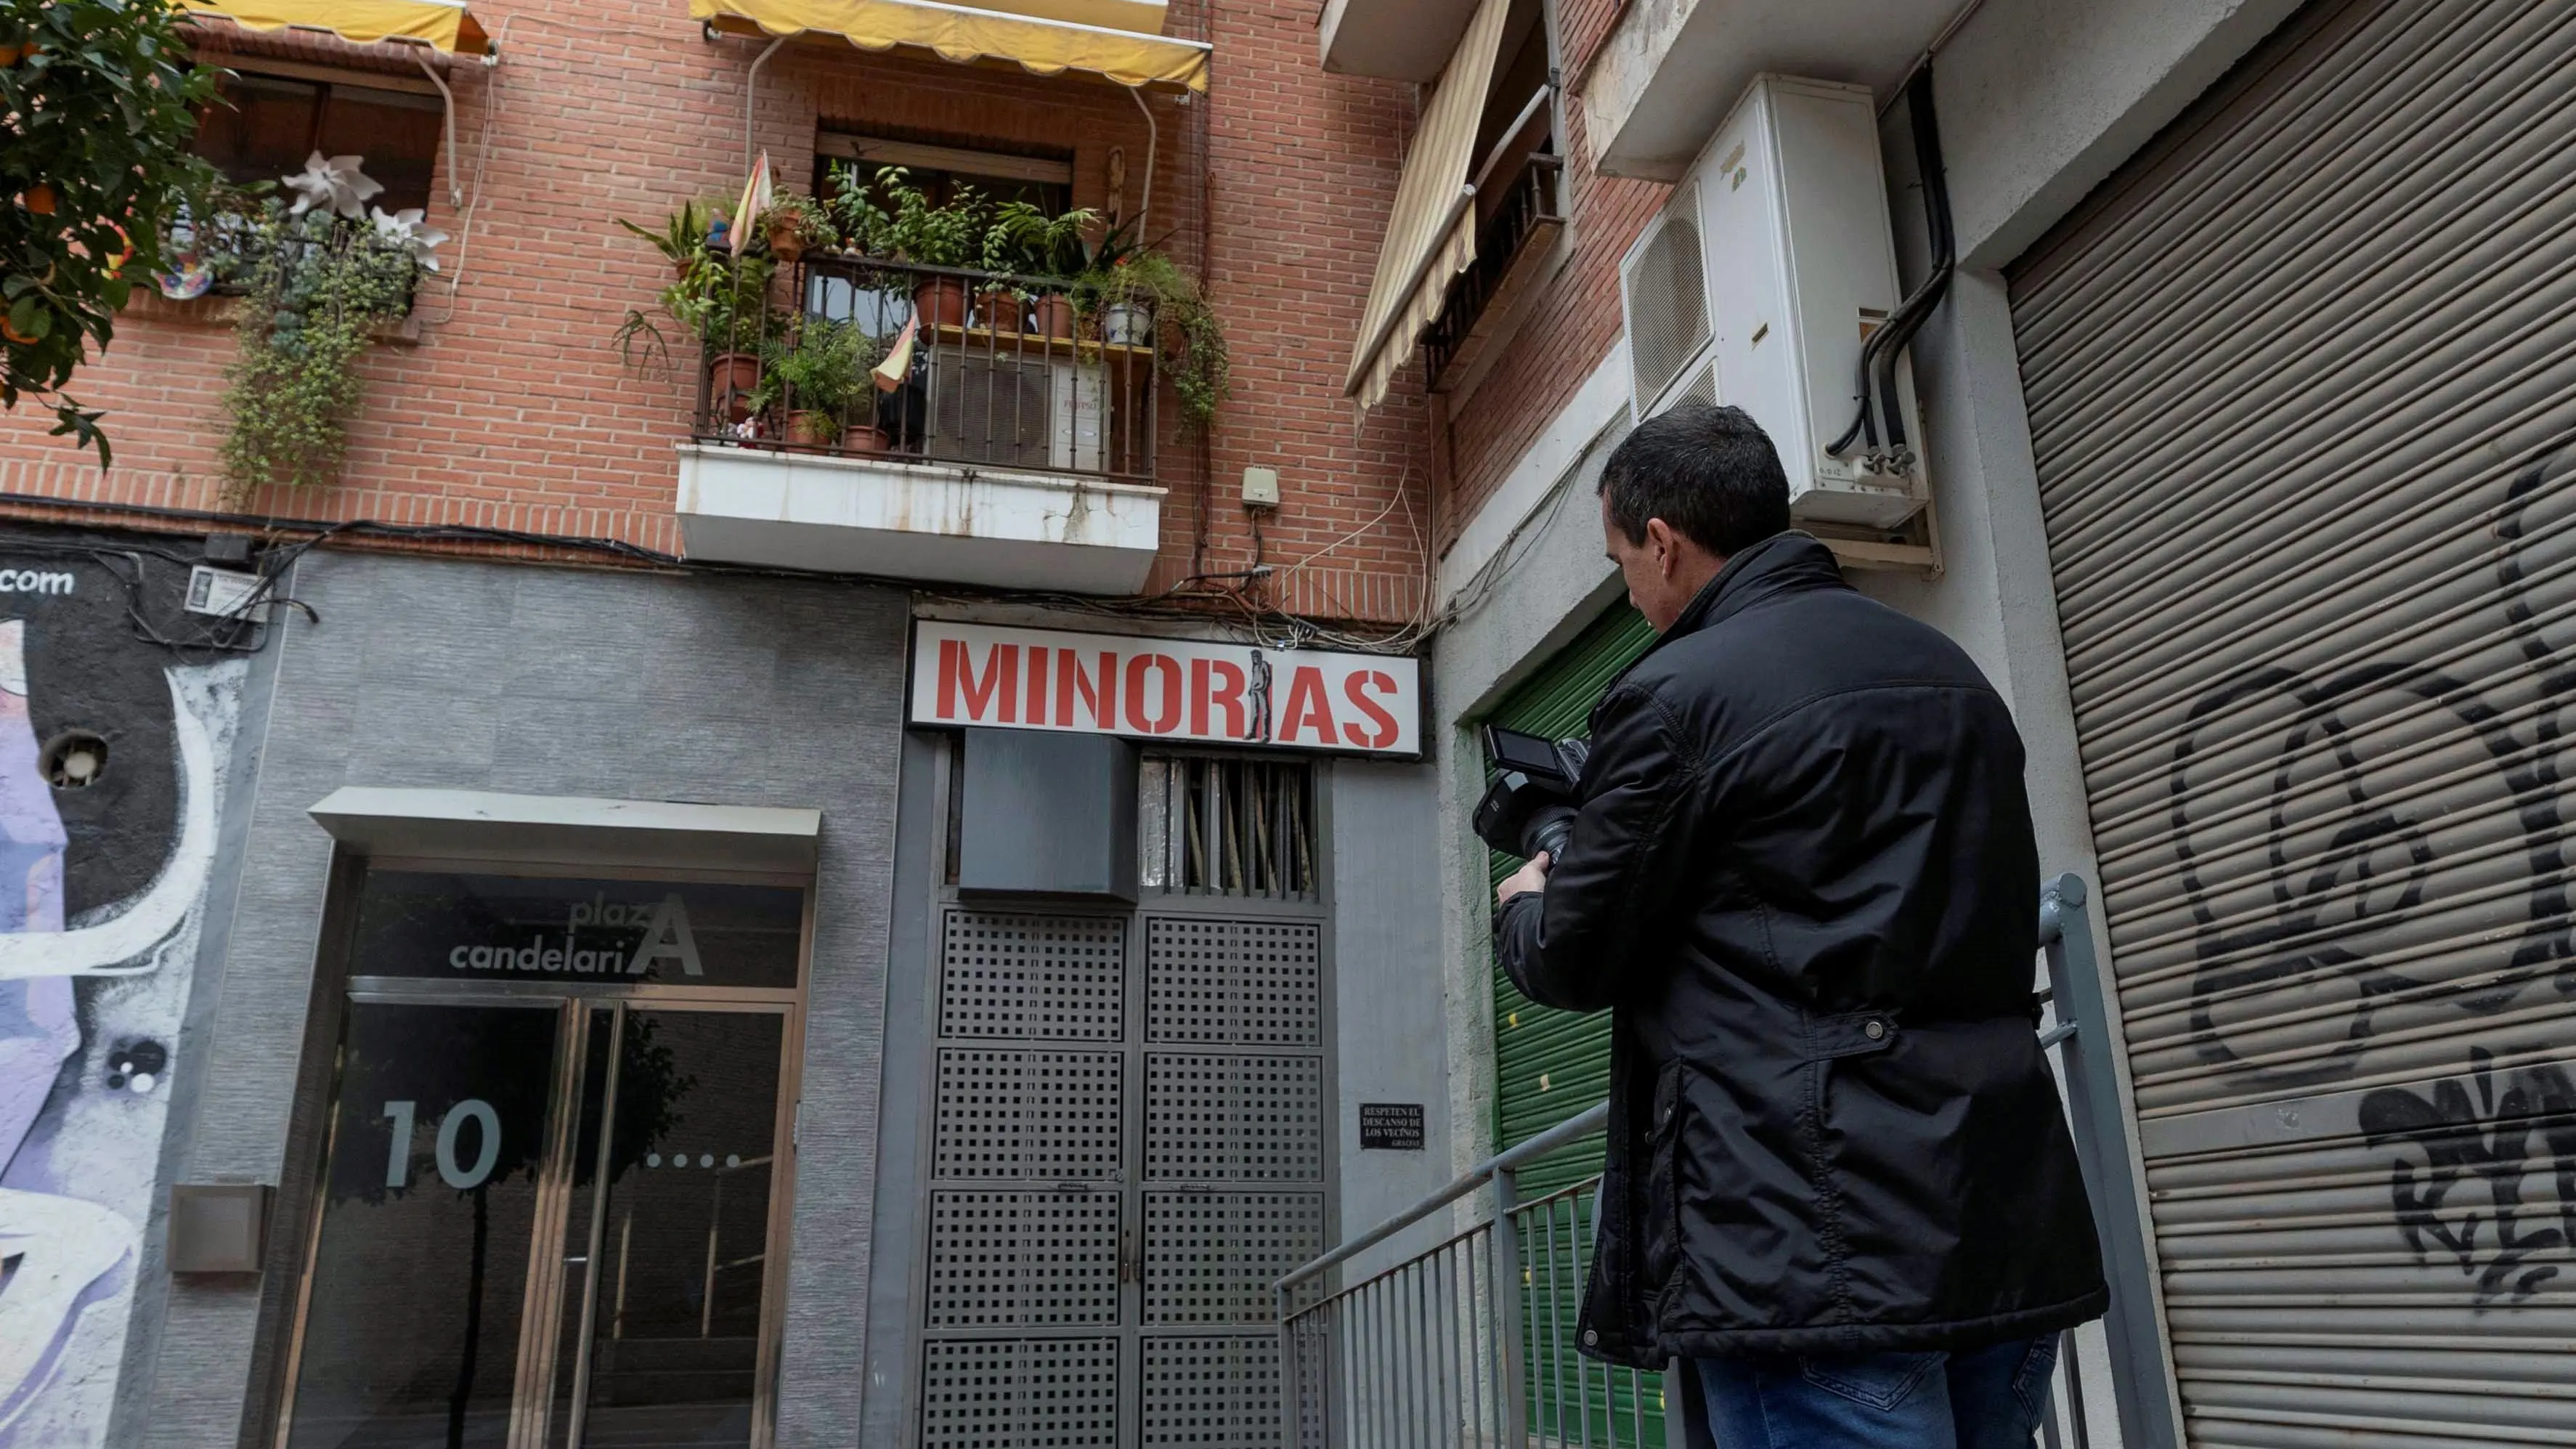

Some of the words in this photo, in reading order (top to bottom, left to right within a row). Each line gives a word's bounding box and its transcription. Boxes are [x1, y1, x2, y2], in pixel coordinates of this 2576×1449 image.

[1365, 1108, 1407, 1116] RESPETEN
[1409, 1108, 1421, 1117] EL
[1362, 1117, 1407, 1127] DESCANSO
[1409, 1118, 1421, 1127] DE
[1365, 1128, 1381, 1137] LOS
[1383, 1128, 1420, 1137] VECINOS
[383, 1100, 501, 1189] 10
